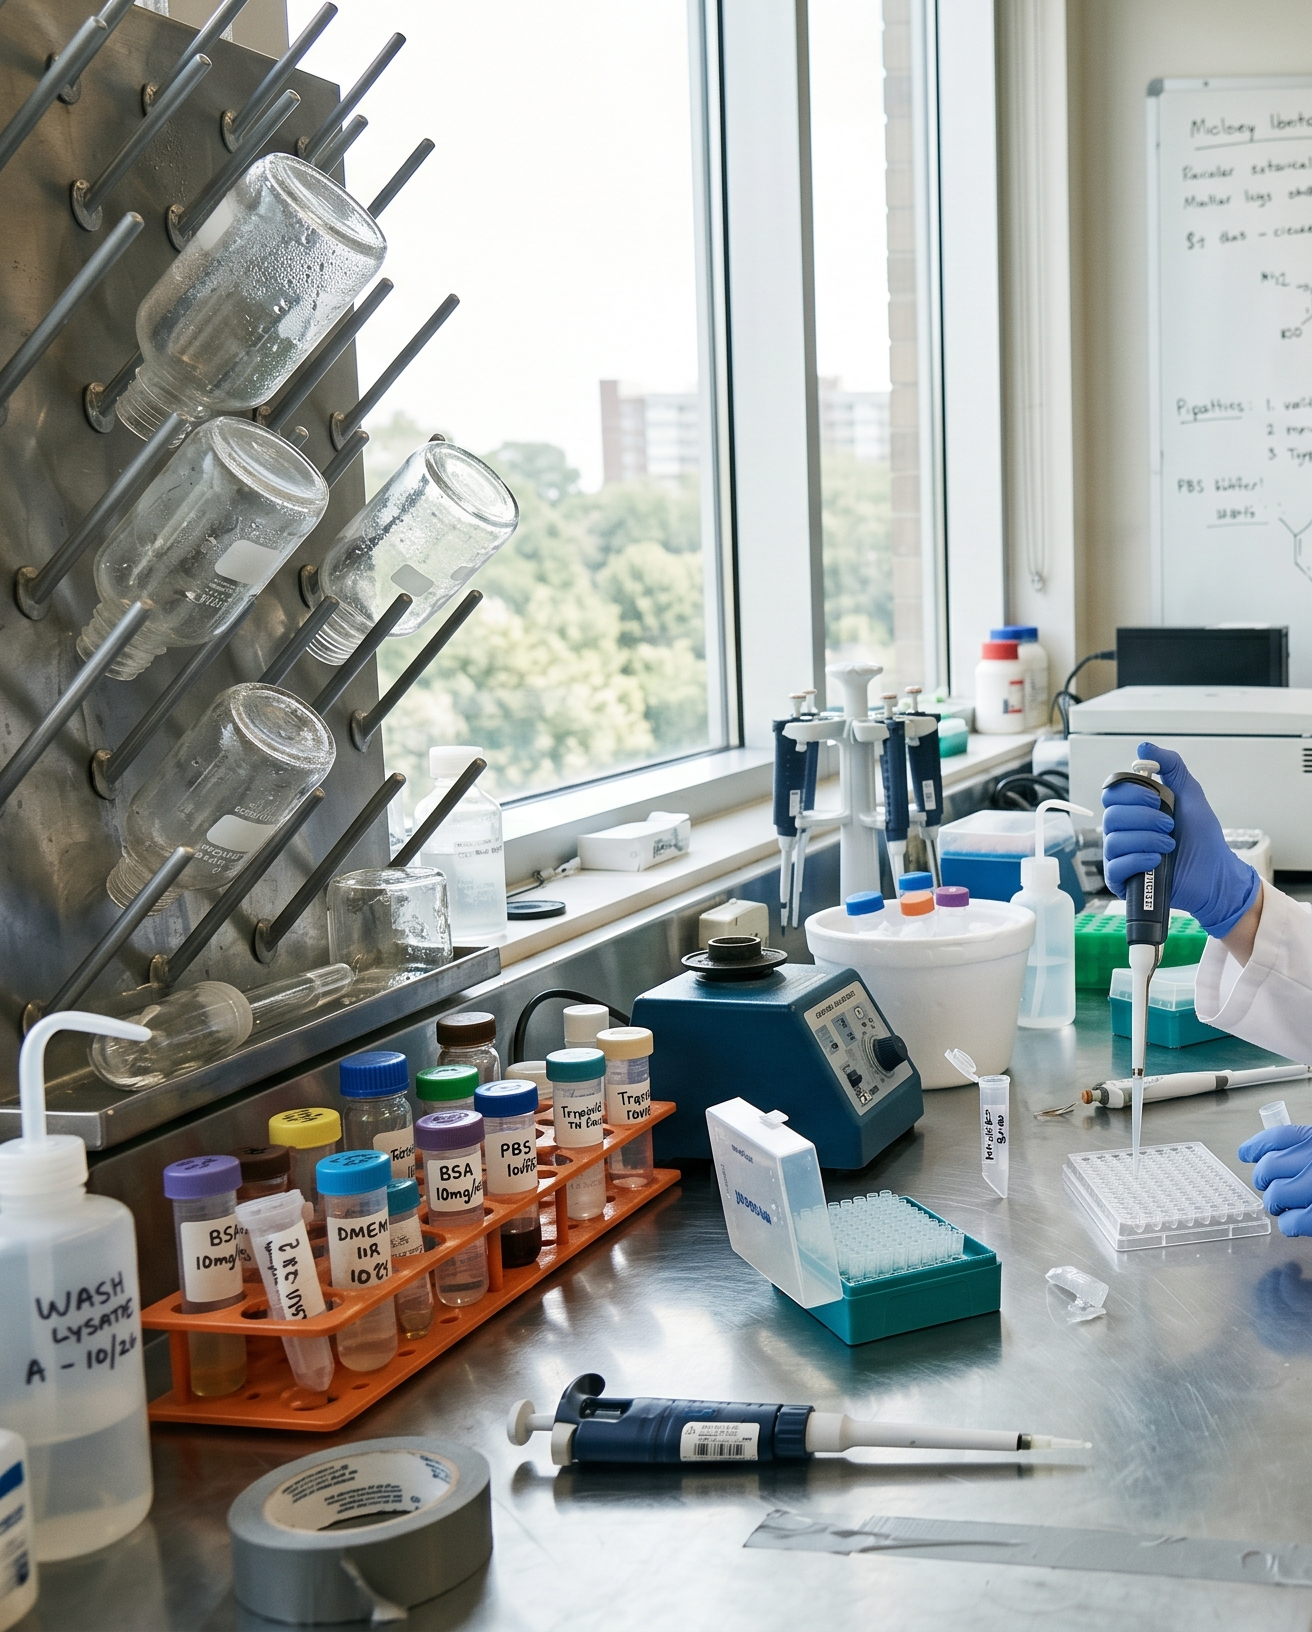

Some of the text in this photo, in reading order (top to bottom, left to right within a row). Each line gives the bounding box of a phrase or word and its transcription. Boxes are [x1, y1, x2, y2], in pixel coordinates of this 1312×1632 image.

[500, 1139, 532, 1159] PBS
[439, 1162, 474, 1182] BSA
[337, 1218, 389, 1242] DMEM
[34, 1270, 125, 1320] WASH
[51, 1297, 135, 1345] LYSATE
[25, 1358, 46, 1386] A
